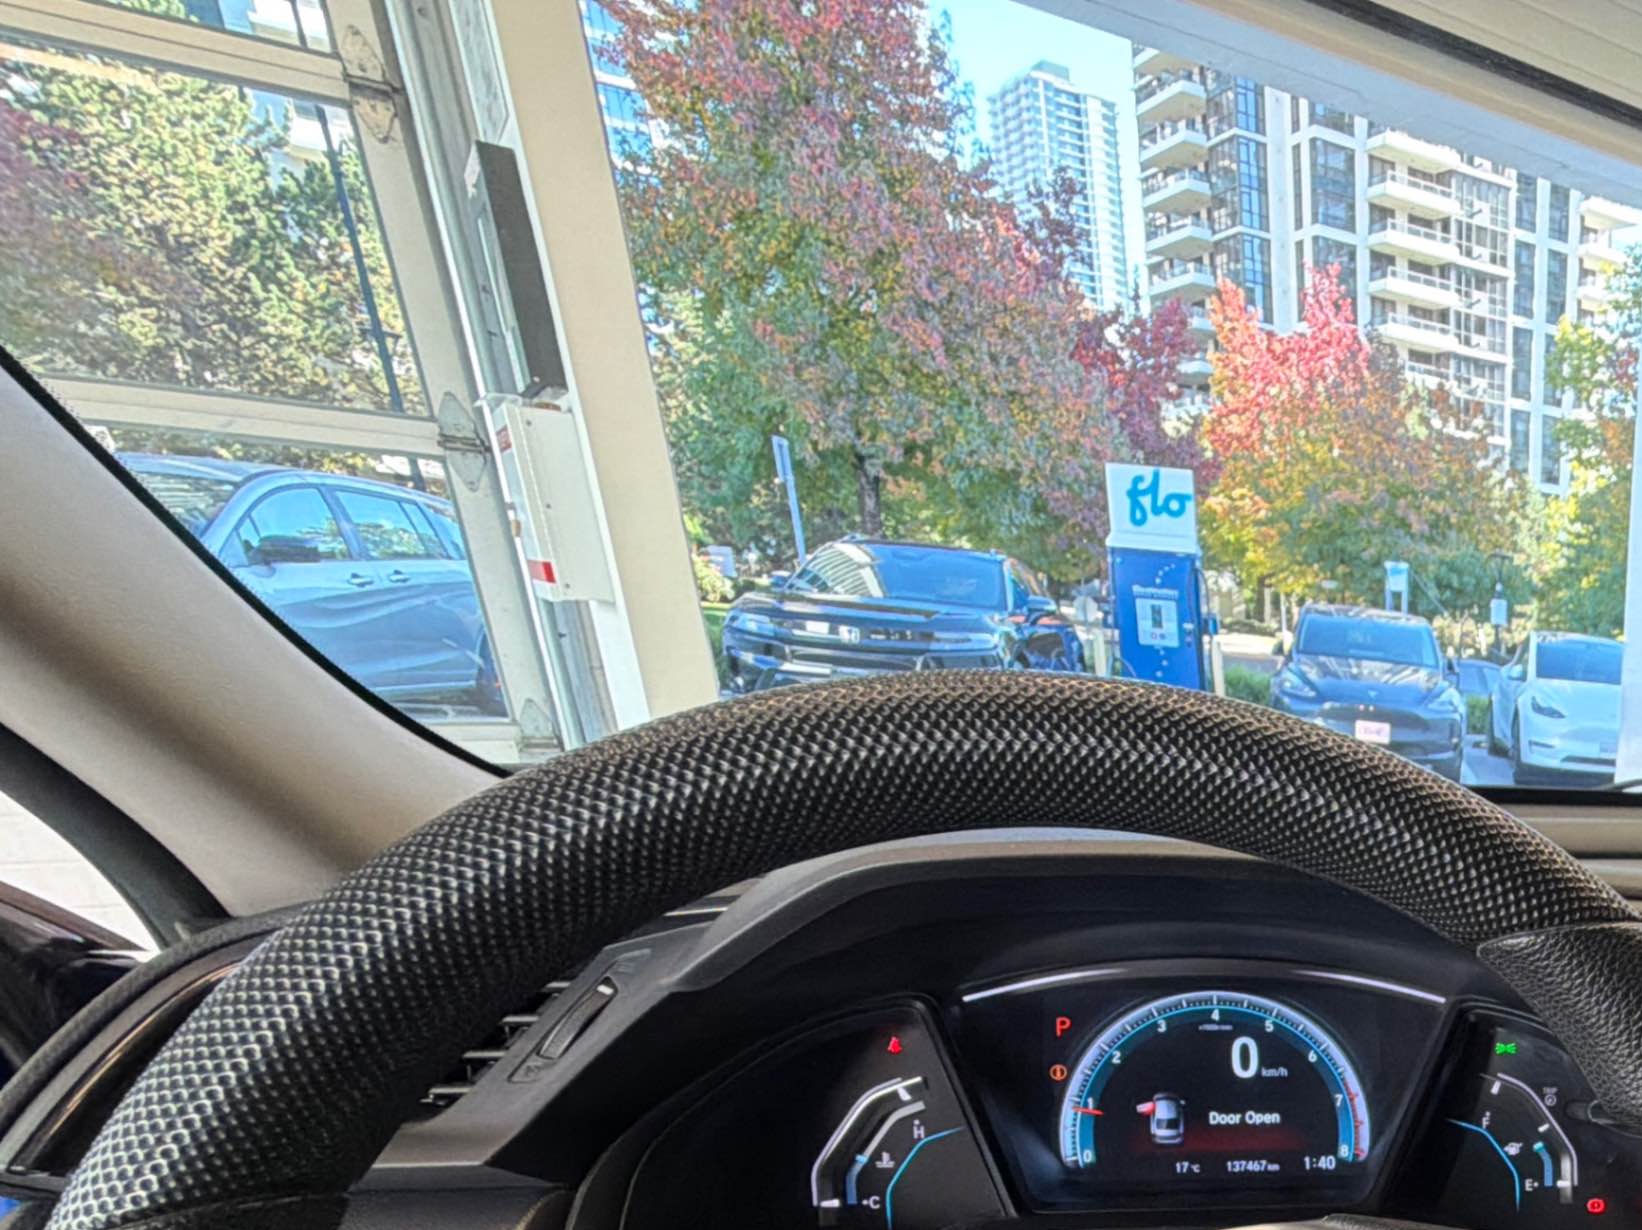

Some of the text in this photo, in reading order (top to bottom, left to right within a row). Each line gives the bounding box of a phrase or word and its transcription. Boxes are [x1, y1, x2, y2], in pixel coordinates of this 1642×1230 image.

[1126, 468, 1193, 527] flo
[1211, 1009, 1220, 1021] 4
[1056, 1017, 1071, 1037] P
[1157, 1020, 1167, 1033] 3
[1265, 1020, 1274, 1033] 5
[1112, 1051, 1121, 1064] 2
[1231, 1036, 1288, 1079] 0 km/h
[1308, 1051, 1318, 1063] 6
[1335, 1094, 1344, 1107] 7
[1208, 1110, 1281, 1125] Door Open
[1482, 1116, 1491, 1129] F
[913, 1126, 925, 1139] H
[1083, 1150, 1092, 1163] 0
[1340, 1145, 1349, 1157] 8
[1304, 1156, 1336, 1170] 1:40
[1524, 1178, 1534, 1192] E
[868, 1196, 881, 1209] C
